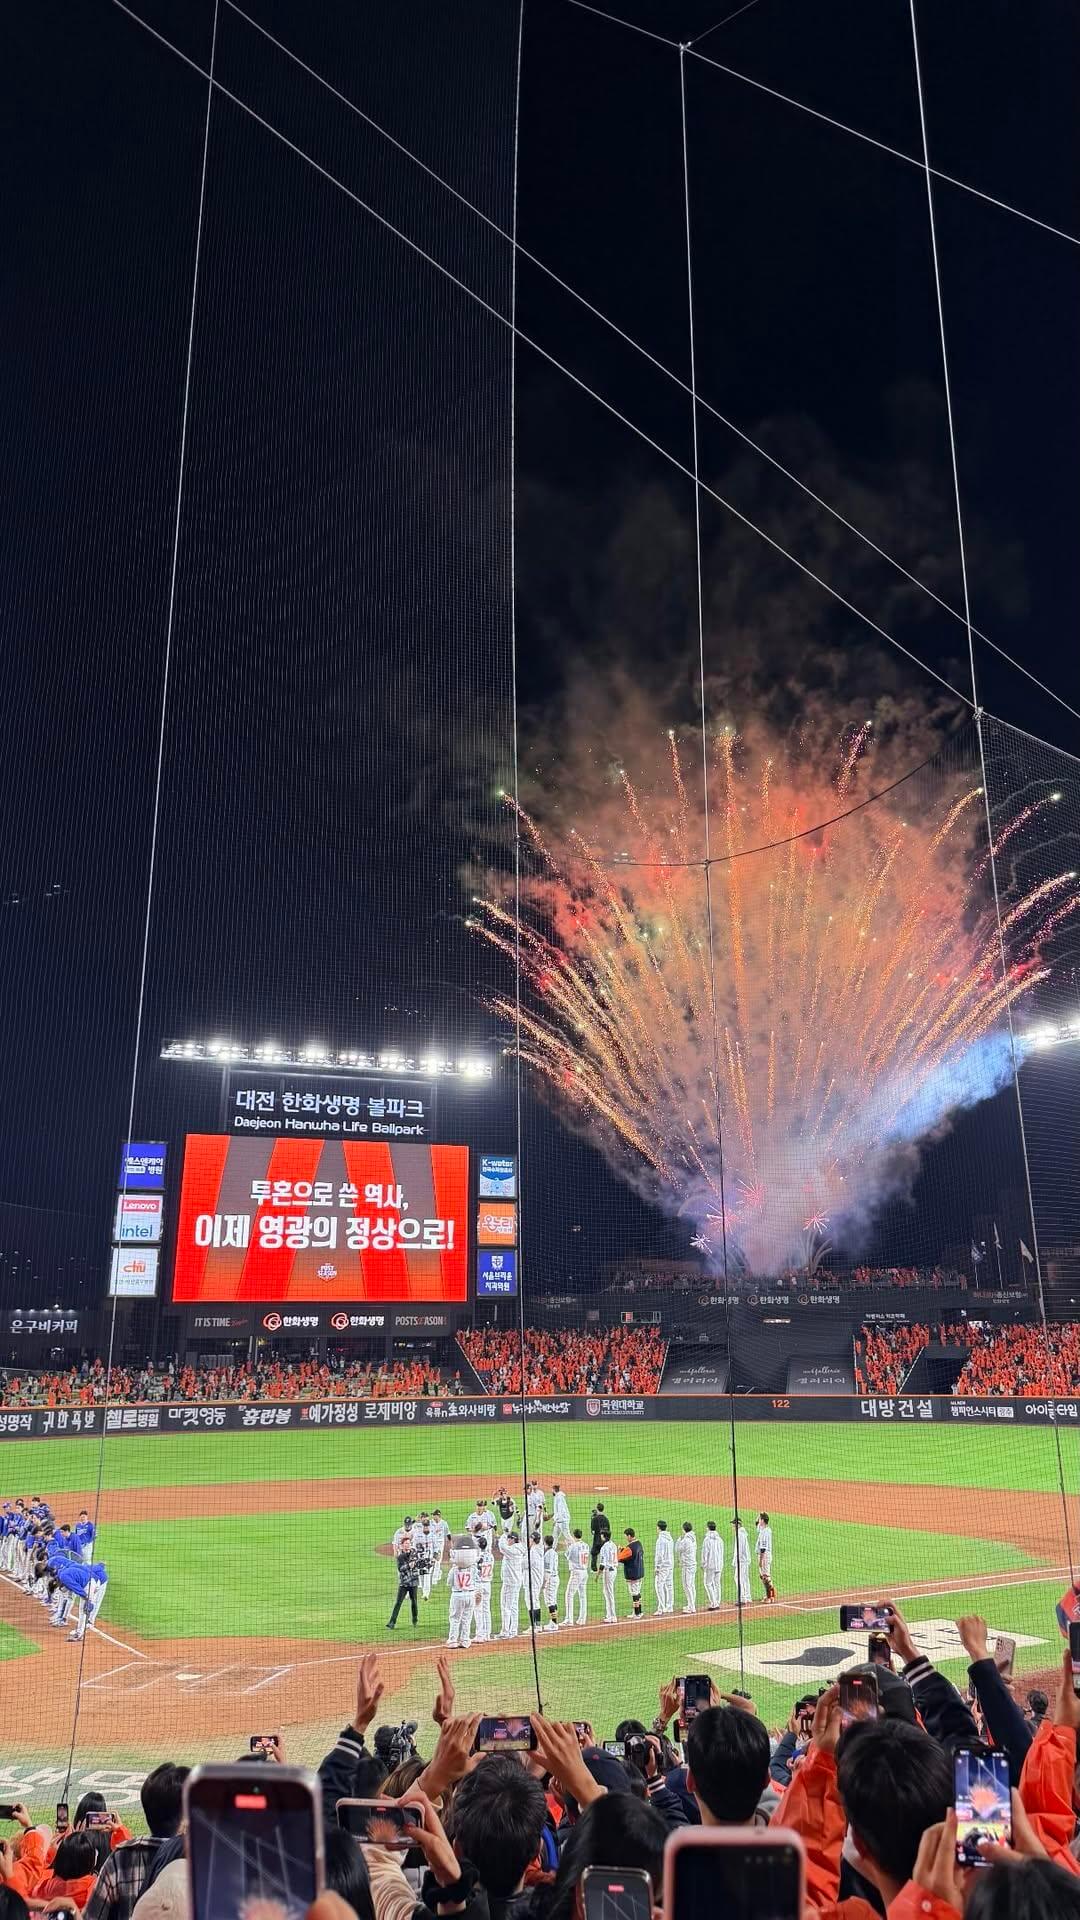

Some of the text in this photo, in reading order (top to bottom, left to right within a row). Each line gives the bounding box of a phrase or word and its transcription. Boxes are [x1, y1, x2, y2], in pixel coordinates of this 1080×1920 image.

[235, 1089, 425, 1118] 대전 한화생명 볼파크
[234, 1116, 425, 1136] Daejeon Hanwha Life Ballpark
[250, 1179, 409, 1210] 투혼으로 쓴 역사,
[123, 1200, 157, 1211] Lenovo
[121, 1224, 153, 1238] intel
[194, 1214, 455, 1251] 이제 영광의 정상으로!
[9, 1319, 78, 1334] 은구비커피
[195, 1317, 203, 1327] IT
[203, 1317, 211, 1327] IS
[212, 1317, 231, 1327] TIME
[282, 1315, 319, 1327] 한화생명
[349, 1315, 385, 1327] 한화생명
[364, 1401, 418, 1421] 로제비앙
[771, 1399, 791, 1408] 122
[861, 1398, 934, 1418] 대방건설
[168, 1407, 227, 1426] 마켓영동
[308, 1403, 359, 1423] 예가정성
[457, 1571, 471, 1588] V2
